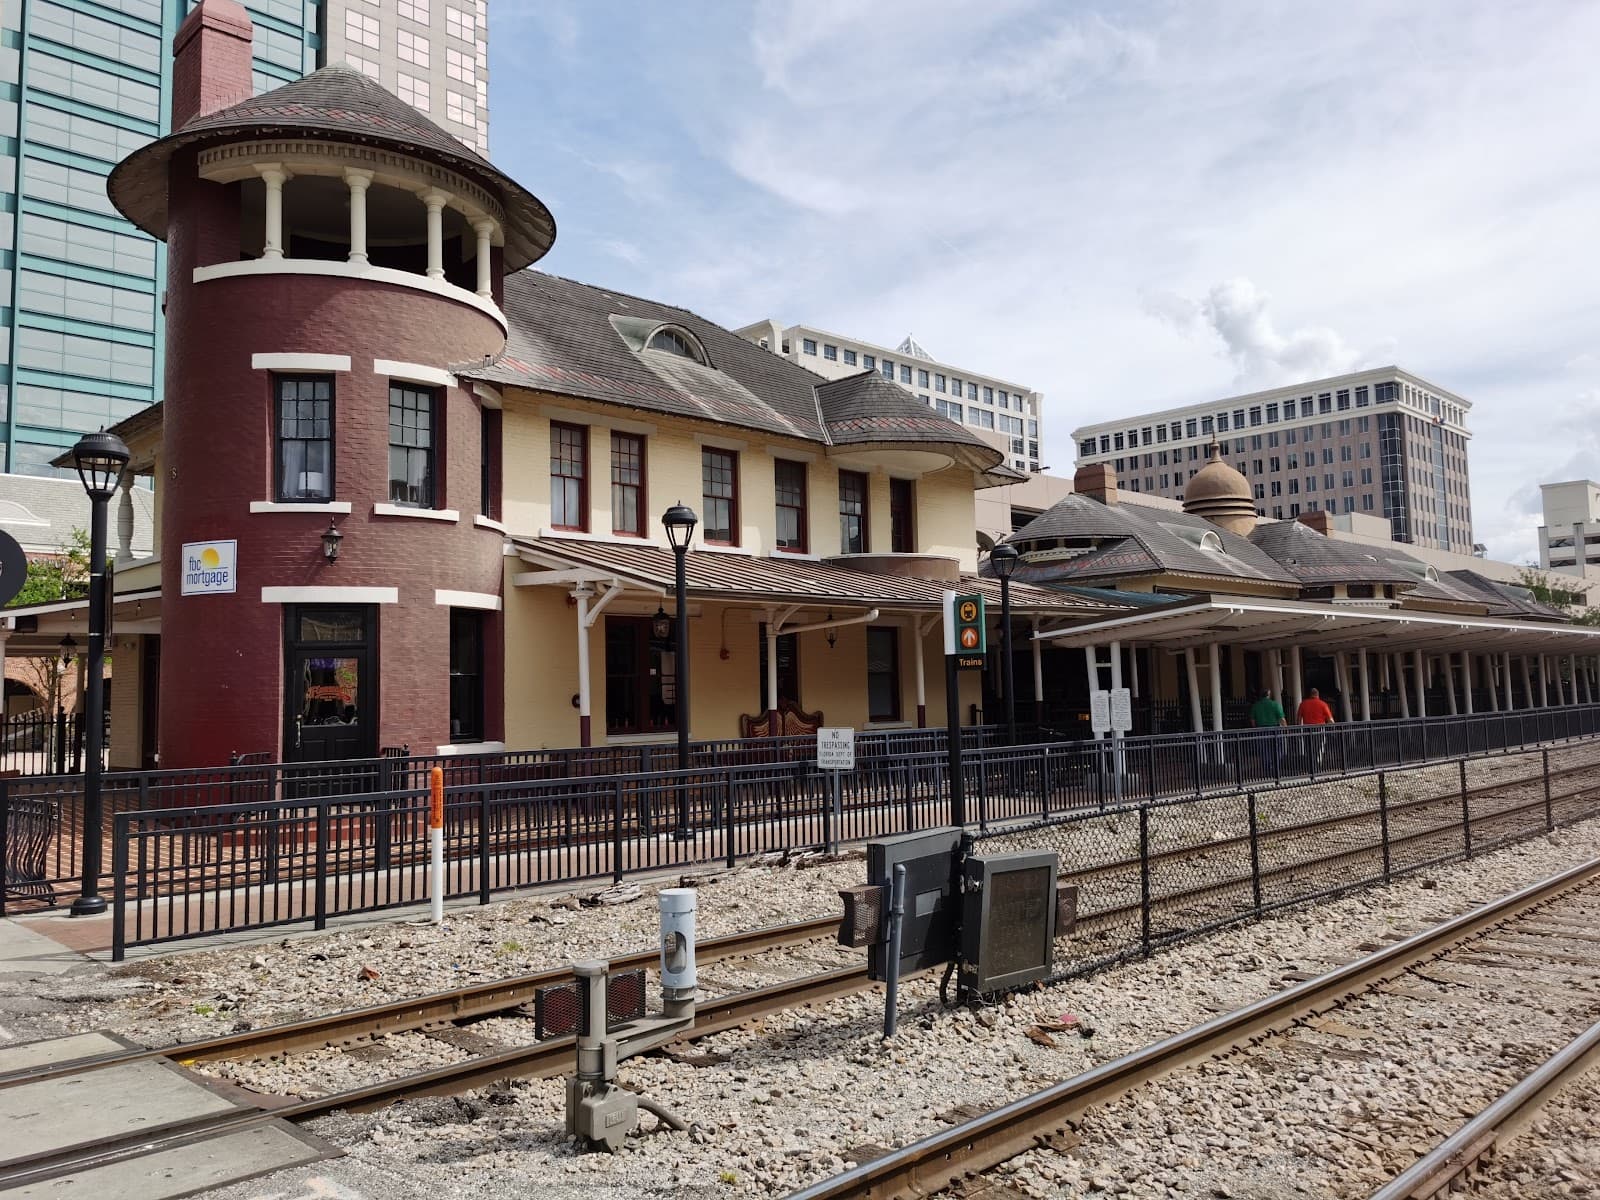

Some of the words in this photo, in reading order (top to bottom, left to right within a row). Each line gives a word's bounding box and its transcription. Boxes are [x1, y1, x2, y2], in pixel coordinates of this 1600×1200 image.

[189, 556, 202, 571] fbc
[186, 570, 229, 587] mortgage
[959, 658, 983, 667] Trains
[831, 731, 840, 739] NO
[821, 741, 850, 750] TRESPASSING
